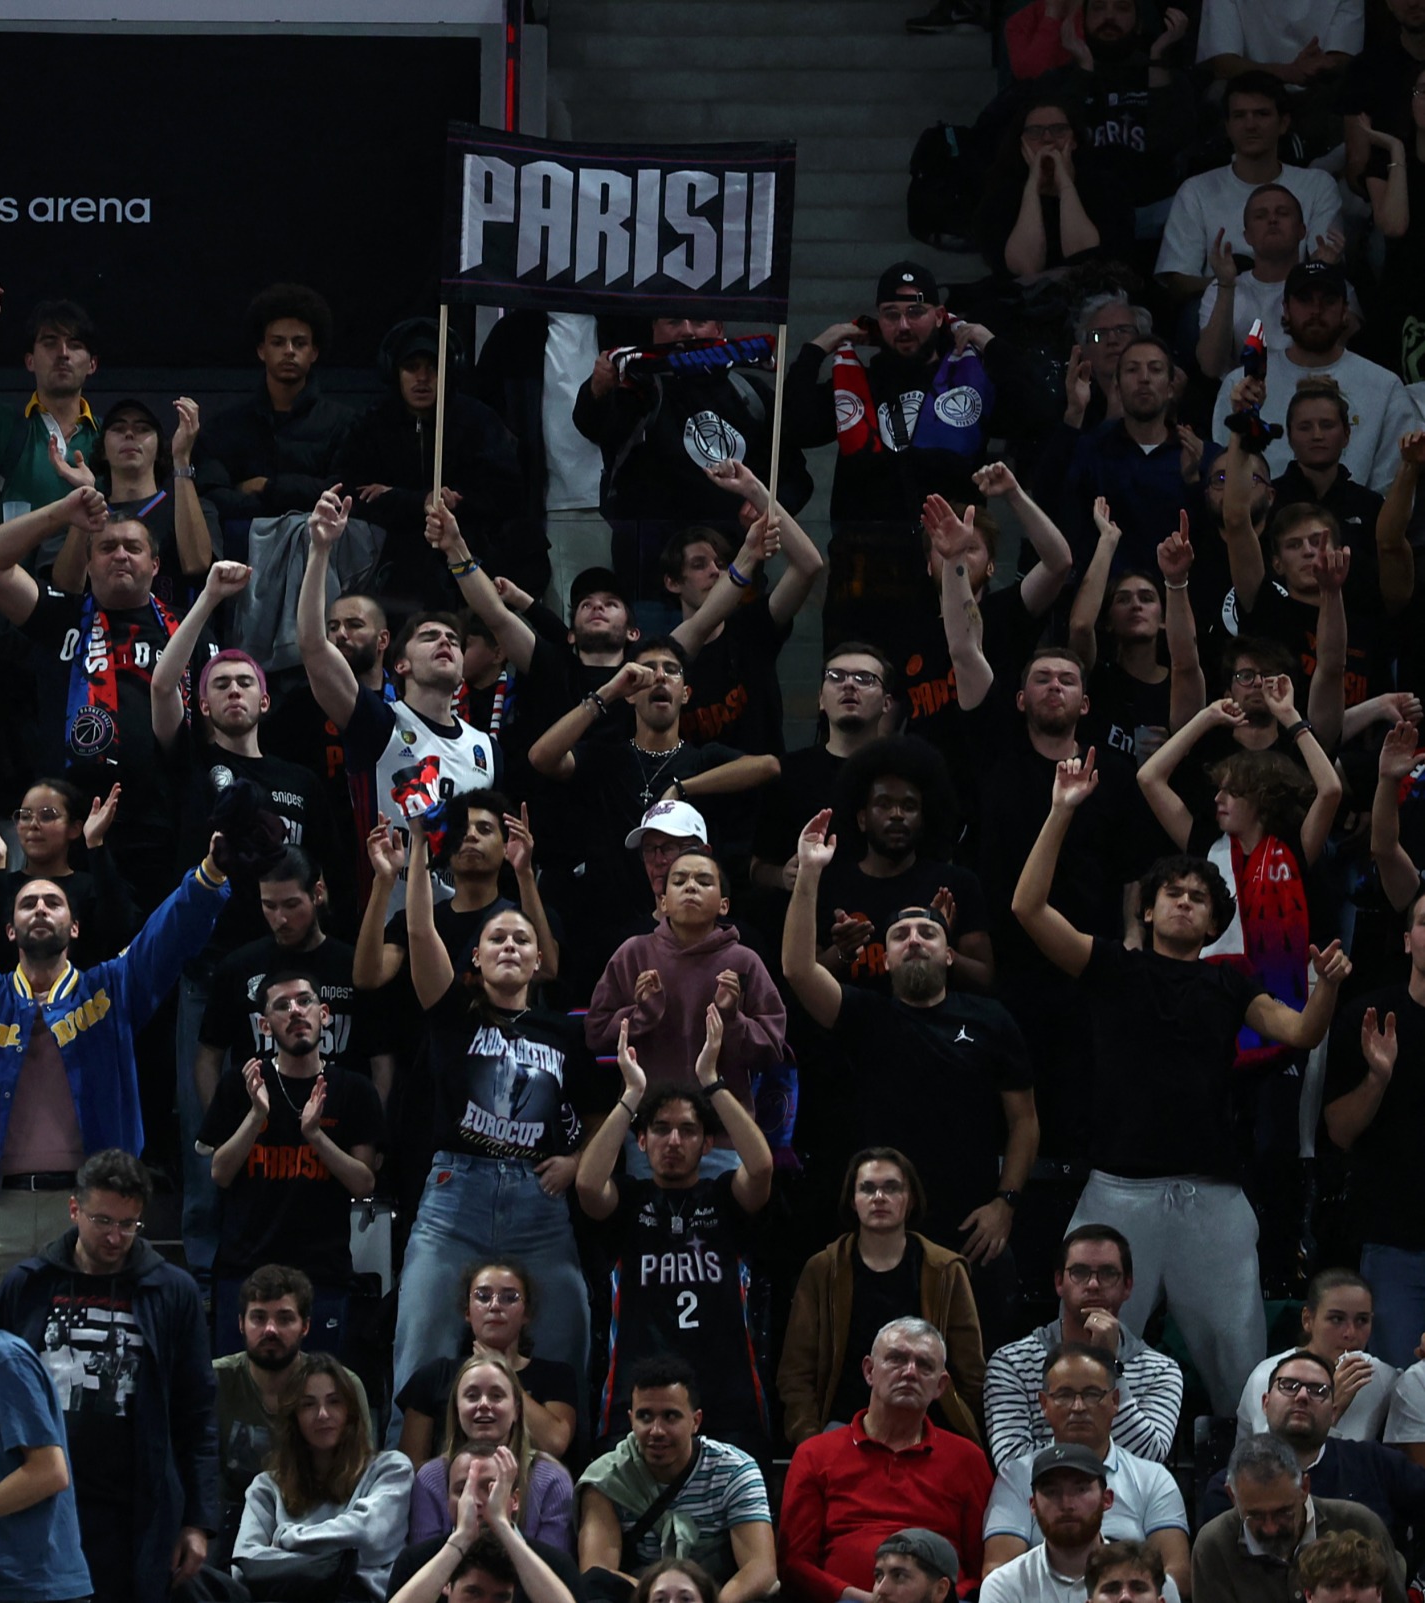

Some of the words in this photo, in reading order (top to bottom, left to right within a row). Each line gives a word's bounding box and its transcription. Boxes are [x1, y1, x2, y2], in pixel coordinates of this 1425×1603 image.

[28, 197, 151, 223] arena
[458, 153, 776, 291] PARISII
[319, 984, 353, 1001] nipes
[460, 1099, 545, 1149] EUROCUP
[640, 1251, 724, 1287] PARIS
[676, 1290, 700, 1330] 2
